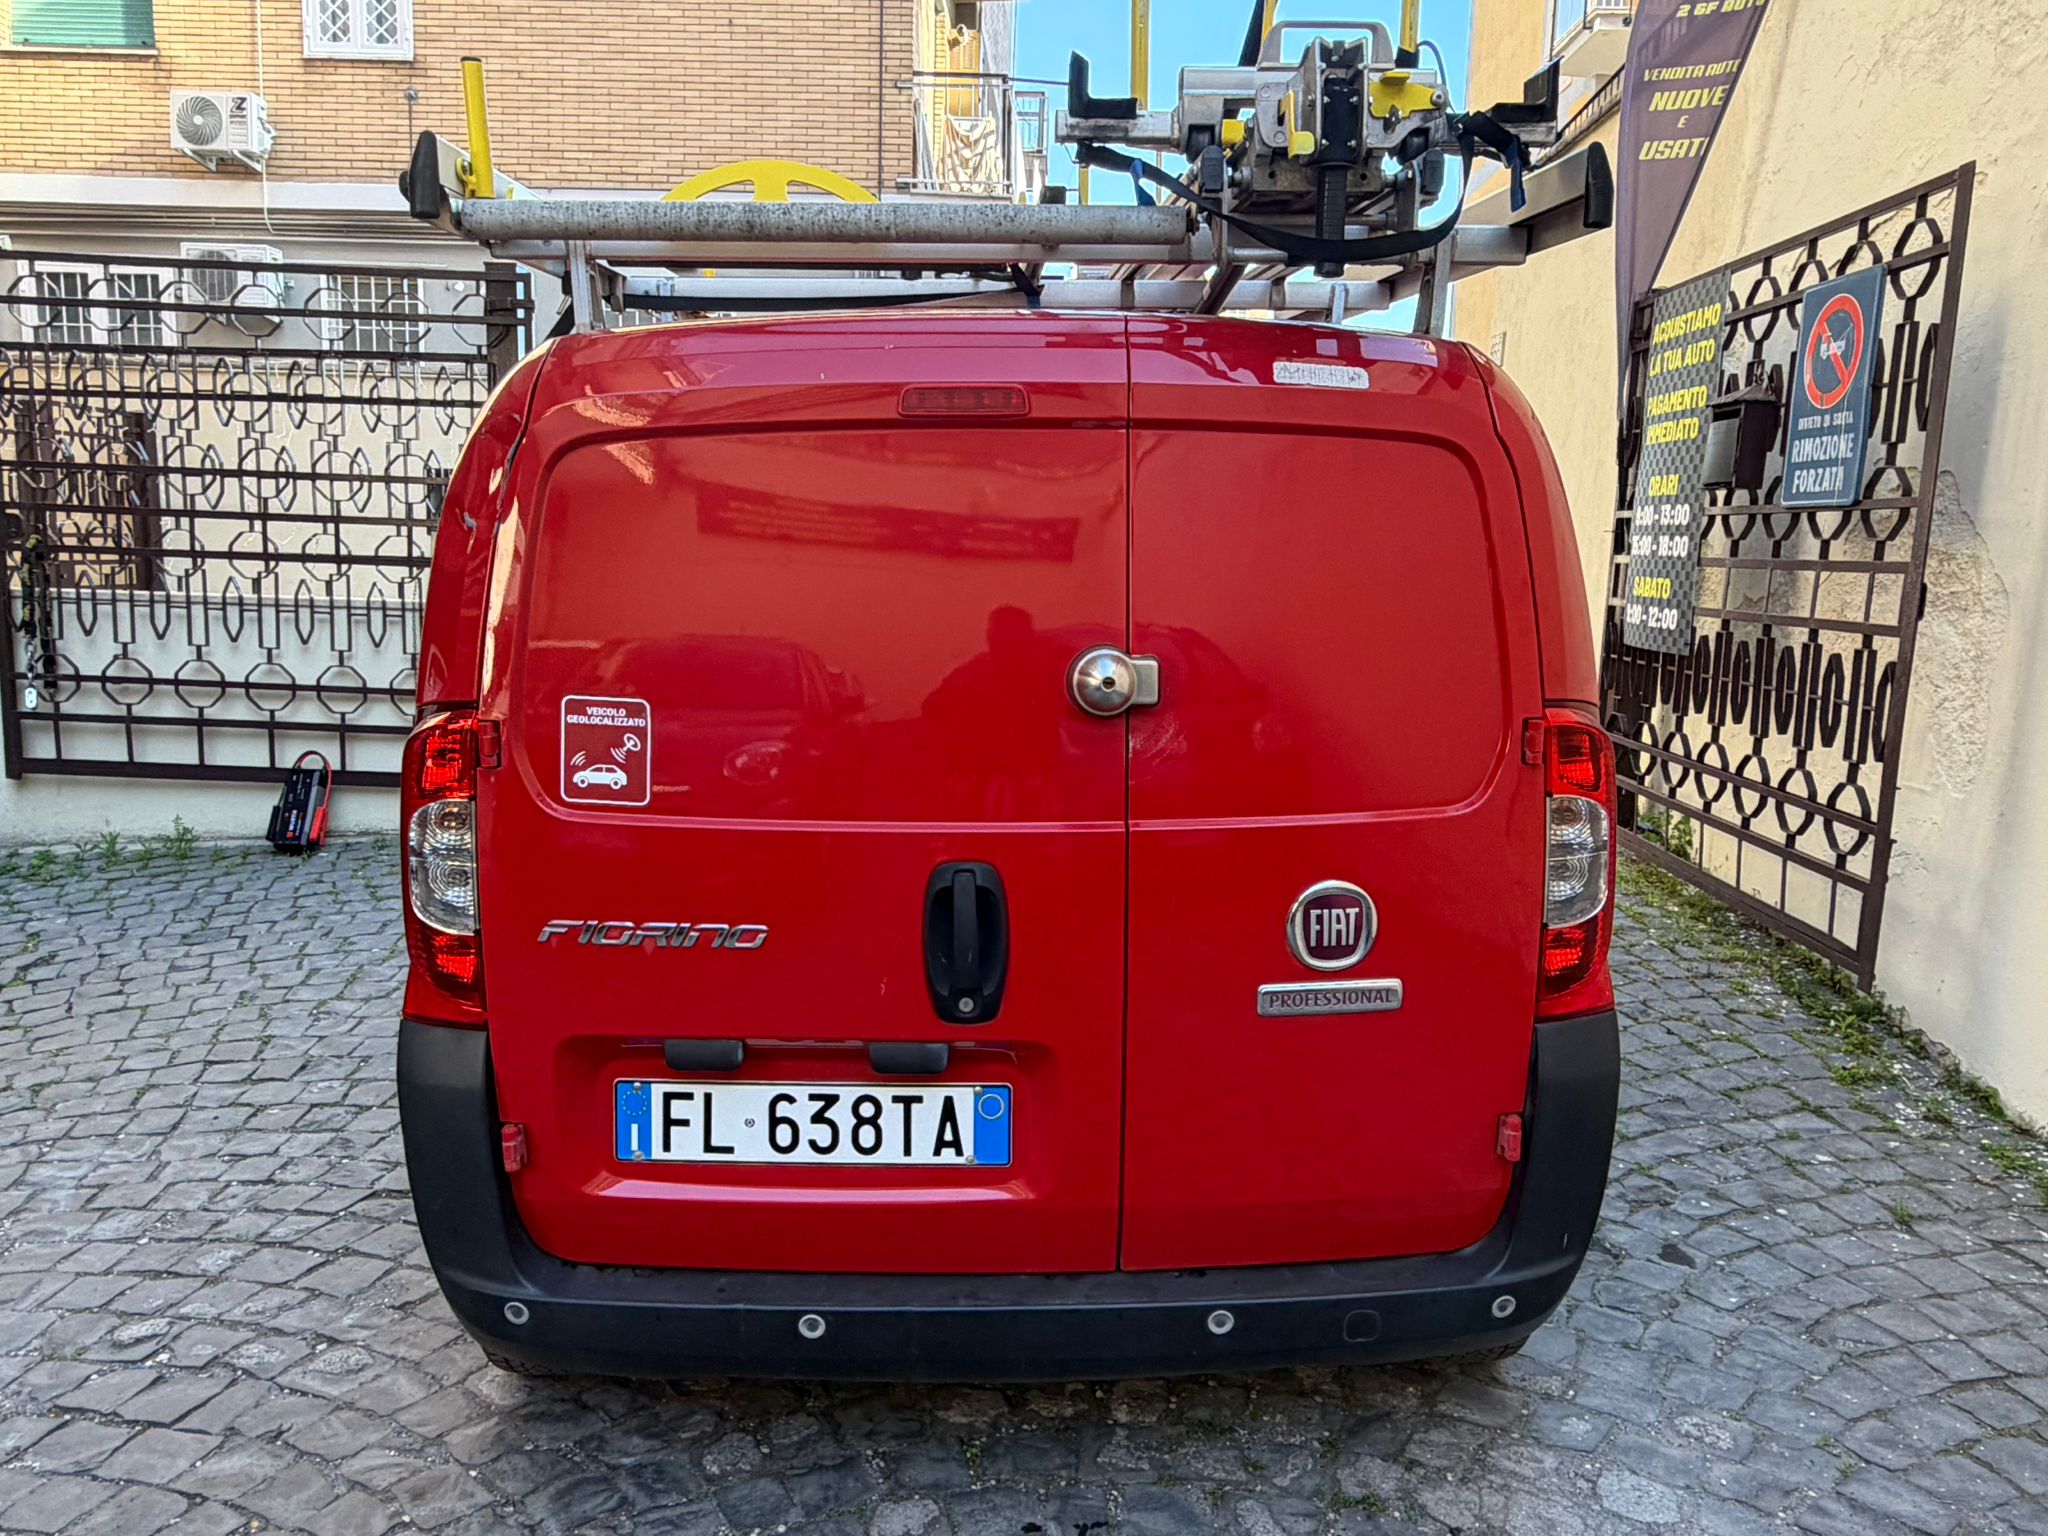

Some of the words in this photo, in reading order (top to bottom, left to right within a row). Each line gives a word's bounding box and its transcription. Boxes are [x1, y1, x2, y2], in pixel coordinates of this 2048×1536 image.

[1643, 65, 1705, 82] VENDITA
[1649, 85, 1730, 112] NUOVE
[1677, 115, 1689, 128] E
[1638, 136, 1710, 161] USAT
[1652, 302, 1722, 346] ACQUISTIAMO
[1650, 352, 1662, 377] LA
[1663, 347, 1683, 372] TUA
[1683, 338, 1716, 367] AUTO
[1647, 384, 1708, 418] PAGAMENTO
[1646, 417, 1700, 446] IMMEDIATO
[1791, 432, 1854, 464] RIMOZIONE
[1648, 474, 1681, 497] ORARI
[1791, 465, 1844, 495] FORZATA
[1660, 503, 1691, 527] 13:00
[1658, 534, 1689, 558] 18:00
[1633, 576, 1673, 600] SABATO
[1647, 605, 1678, 631] 12:00
[566, 714, 646, 727] GEOLOCALIZZATO
[586, 706, 626, 717] VEICOLO
[1309, 907, 1360, 948] FIAT
[1268, 988, 1393, 1009] PROFESSIONAL
